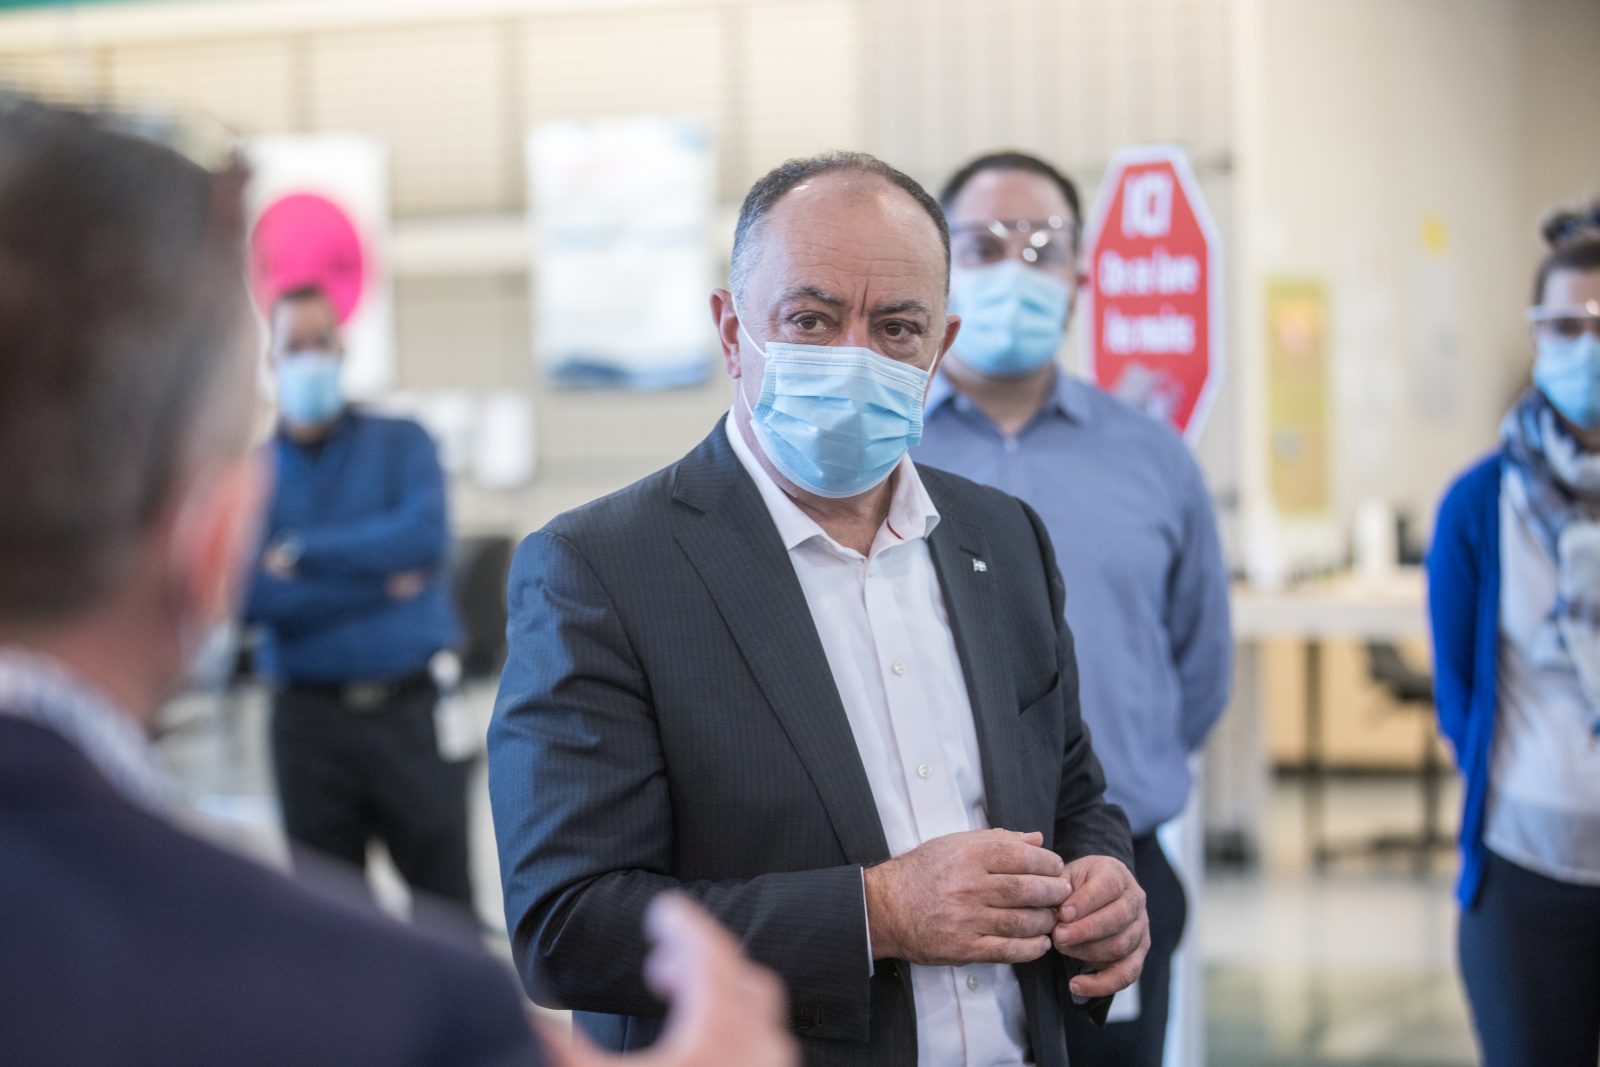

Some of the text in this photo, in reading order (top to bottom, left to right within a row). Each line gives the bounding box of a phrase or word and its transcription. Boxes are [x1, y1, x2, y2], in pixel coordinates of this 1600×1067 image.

[1153, 246, 1198, 293] lave
[1104, 306, 1196, 353] les mains
